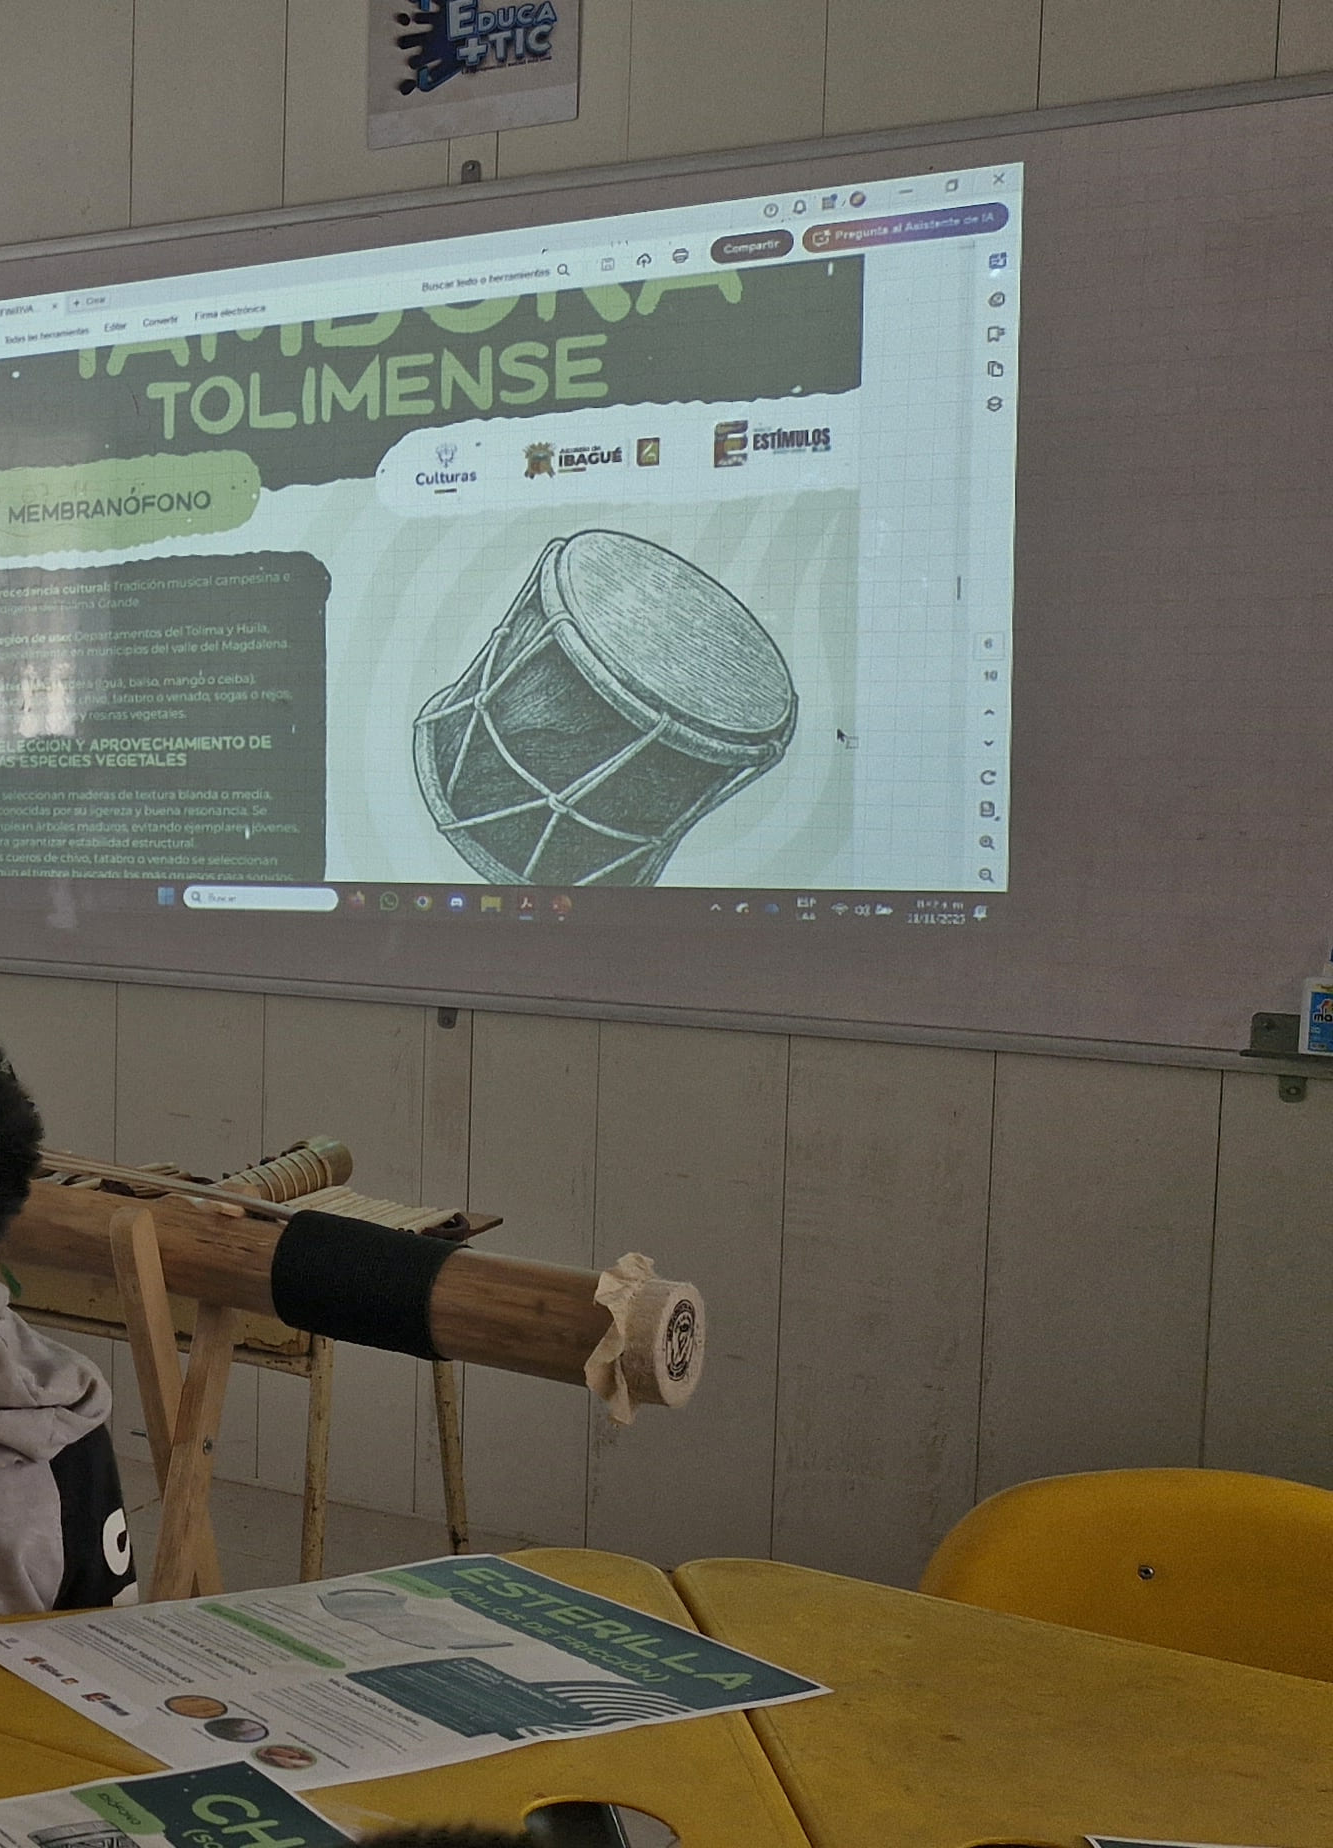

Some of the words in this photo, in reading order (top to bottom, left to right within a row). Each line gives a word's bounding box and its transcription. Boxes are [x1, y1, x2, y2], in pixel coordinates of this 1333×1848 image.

[447, 0, 557, 40] EDUCA
[835, 227, 888, 241] Pregunta
[892, 224, 903, 234] al
[905, 216, 960, 232] Asistente
[963, 214, 979, 225] de
[982, 211, 995, 222] IA
[723, 239, 781, 255] Compartir
[421, 279, 454, 293] Buscar
[142, 315, 178, 328] Convertir
[194, 310, 218, 321] Firma
[4, 335, 26, 345] Todas
[39, 326, 90, 341] herramientas
[104, 323, 127, 333] Editar
[146, 333, 609, 440] TOLIMENSE
[752, 427, 832, 451] ESTÍMULOS
[558, 447, 624, 468] IBAGUÉ
[415, 470, 478, 487] Culturas
[7, 485, 212, 526] MEMBRANÓFONO
[62, 580, 111, 595] cultural:
[113, 577, 165, 591] Tradición
[167, 575, 212, 590] musical
[214, 572, 281, 588] campesina
[32, 632, 46, 644] de
[73, 628, 163, 643] Departamentos
[164, 626, 183, 639] del
[185, 624, 224, 637] Tolima
[226, 626, 234, 638] y
[87, 643, 150, 659] municipios
[151, 643, 169, 655] del
[171, 641, 198, 654] valle
[200, 640, 219, 653] del
[207, 674, 216, 686] o
[113, 692, 154, 705] tatabro
[165, 691, 211, 703] venado,
[214, 690, 248, 704] sogas
[75, 738, 86, 753] Y
[89, 735, 246, 752] APROVECHAMIENTO
[248, 734, 273, 750] DE
[19, 753, 93, 768] ESPECIES
[95, 752, 188, 768] VEGETALES
[2, 789, 66, 801] seleccionan
[67, 789, 117, 801] maderas
[118, 788, 133, 800] de
[134, 789, 176, 800] textura
[178, 788, 219, 801] blanda
[53, 806, 72, 821] por
[74, 807, 87, 817] su
[89, 805, 133, 819] ligereza
[144, 804, 182, 817] buena
[251, 804, 269, 817] Se
[131, 821, 183, 834] evitando
[12, 837, 68, 850] garantizar
[68, 836, 131, 849] estabilidad
[5, 853, 43, 864] cueros
[44, 852, 59, 863] de
[60, 852, 93, 865] chivo,
[94, 852, 136, 865] tatabro
[147, 854, 191, 866] venado
[192, 856, 206, 866] se
[207, 854, 279, 867] seleccionan
[447, 1587, 526, 1621] (PALOS
[520, 1621, 560, 1636] DE
[453, 1567, 753, 1690] ESTERILLA
